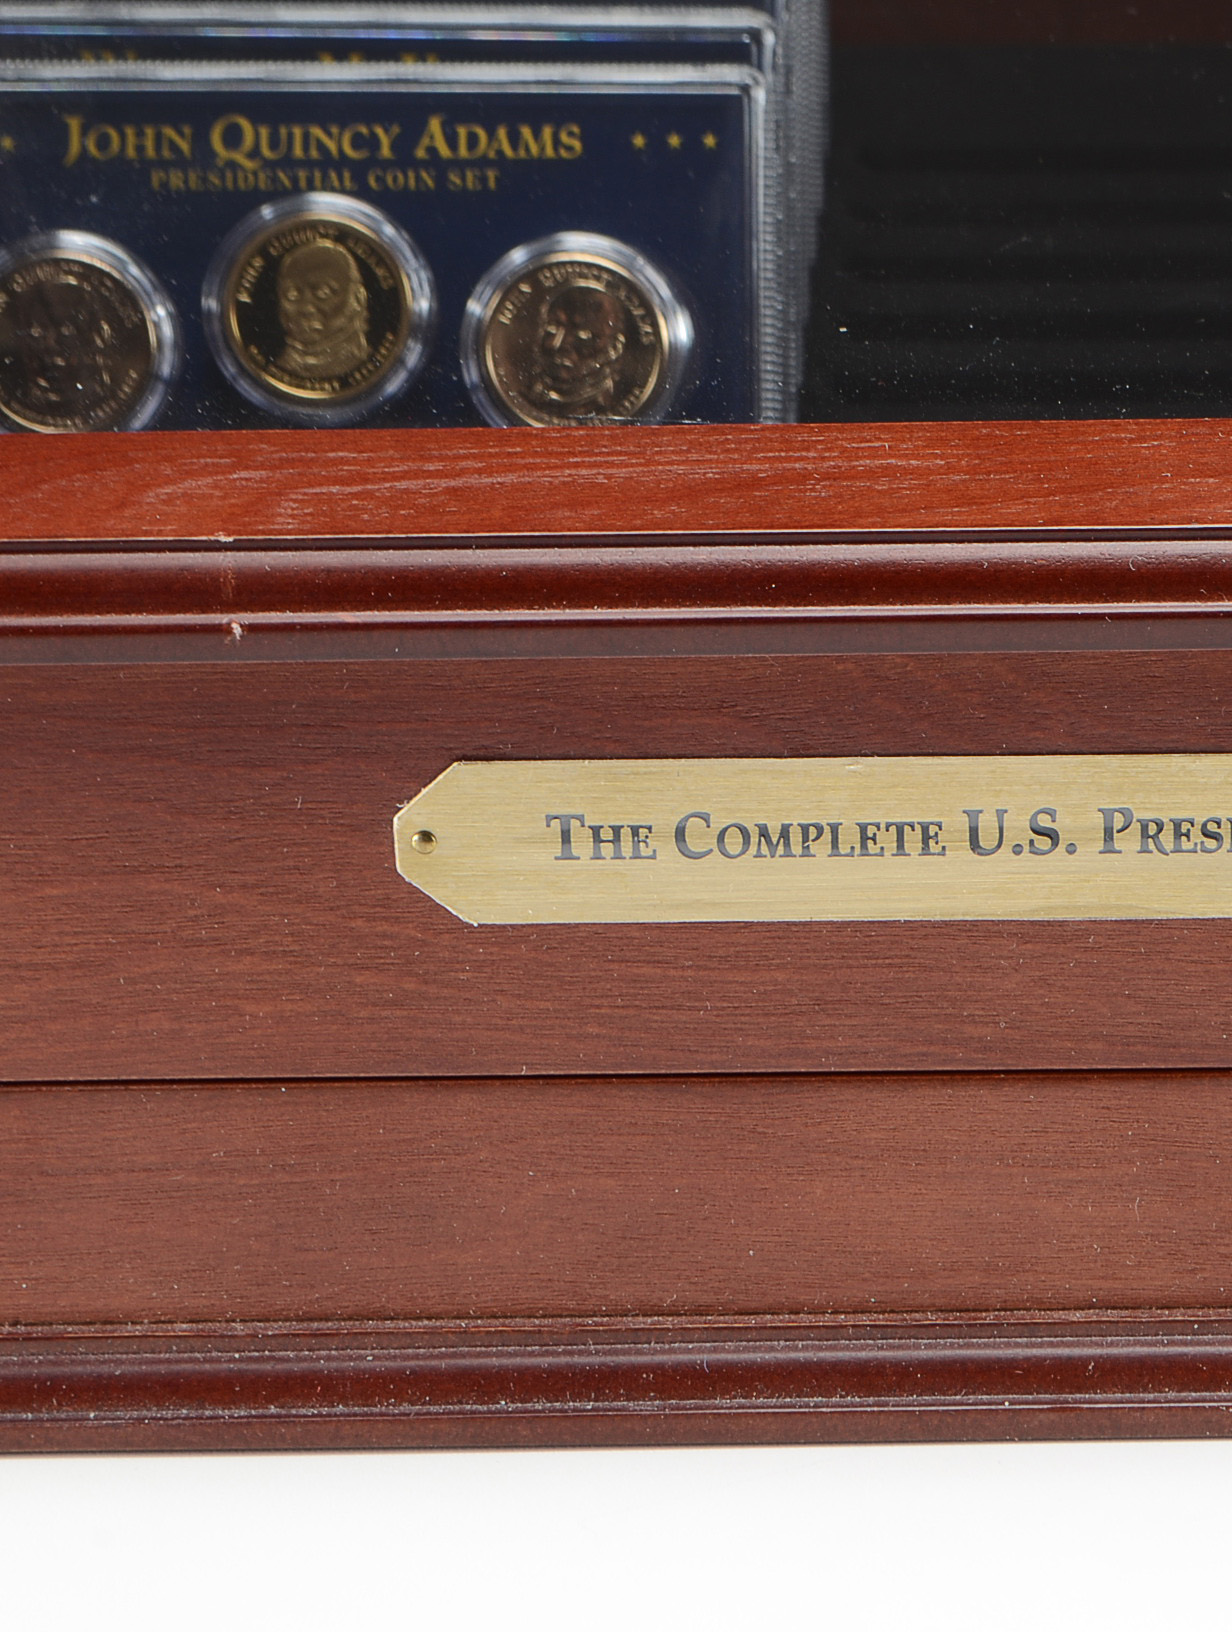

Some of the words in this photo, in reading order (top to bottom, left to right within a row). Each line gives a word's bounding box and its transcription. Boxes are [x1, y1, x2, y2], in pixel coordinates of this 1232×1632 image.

[64, 116, 192, 164] JOHN
[210, 115, 400, 169] QUINCY
[416, 115, 582, 160] ADAMS
[151, 169, 356, 194] PRESIDENTIAL
[368, 169, 436, 190] COIN
[448, 169, 498, 190] SET
[546, 814, 656, 860] THE
[675, 812, 946, 859] COMPLETE
[963, 808, 1076, 856] U.S.
